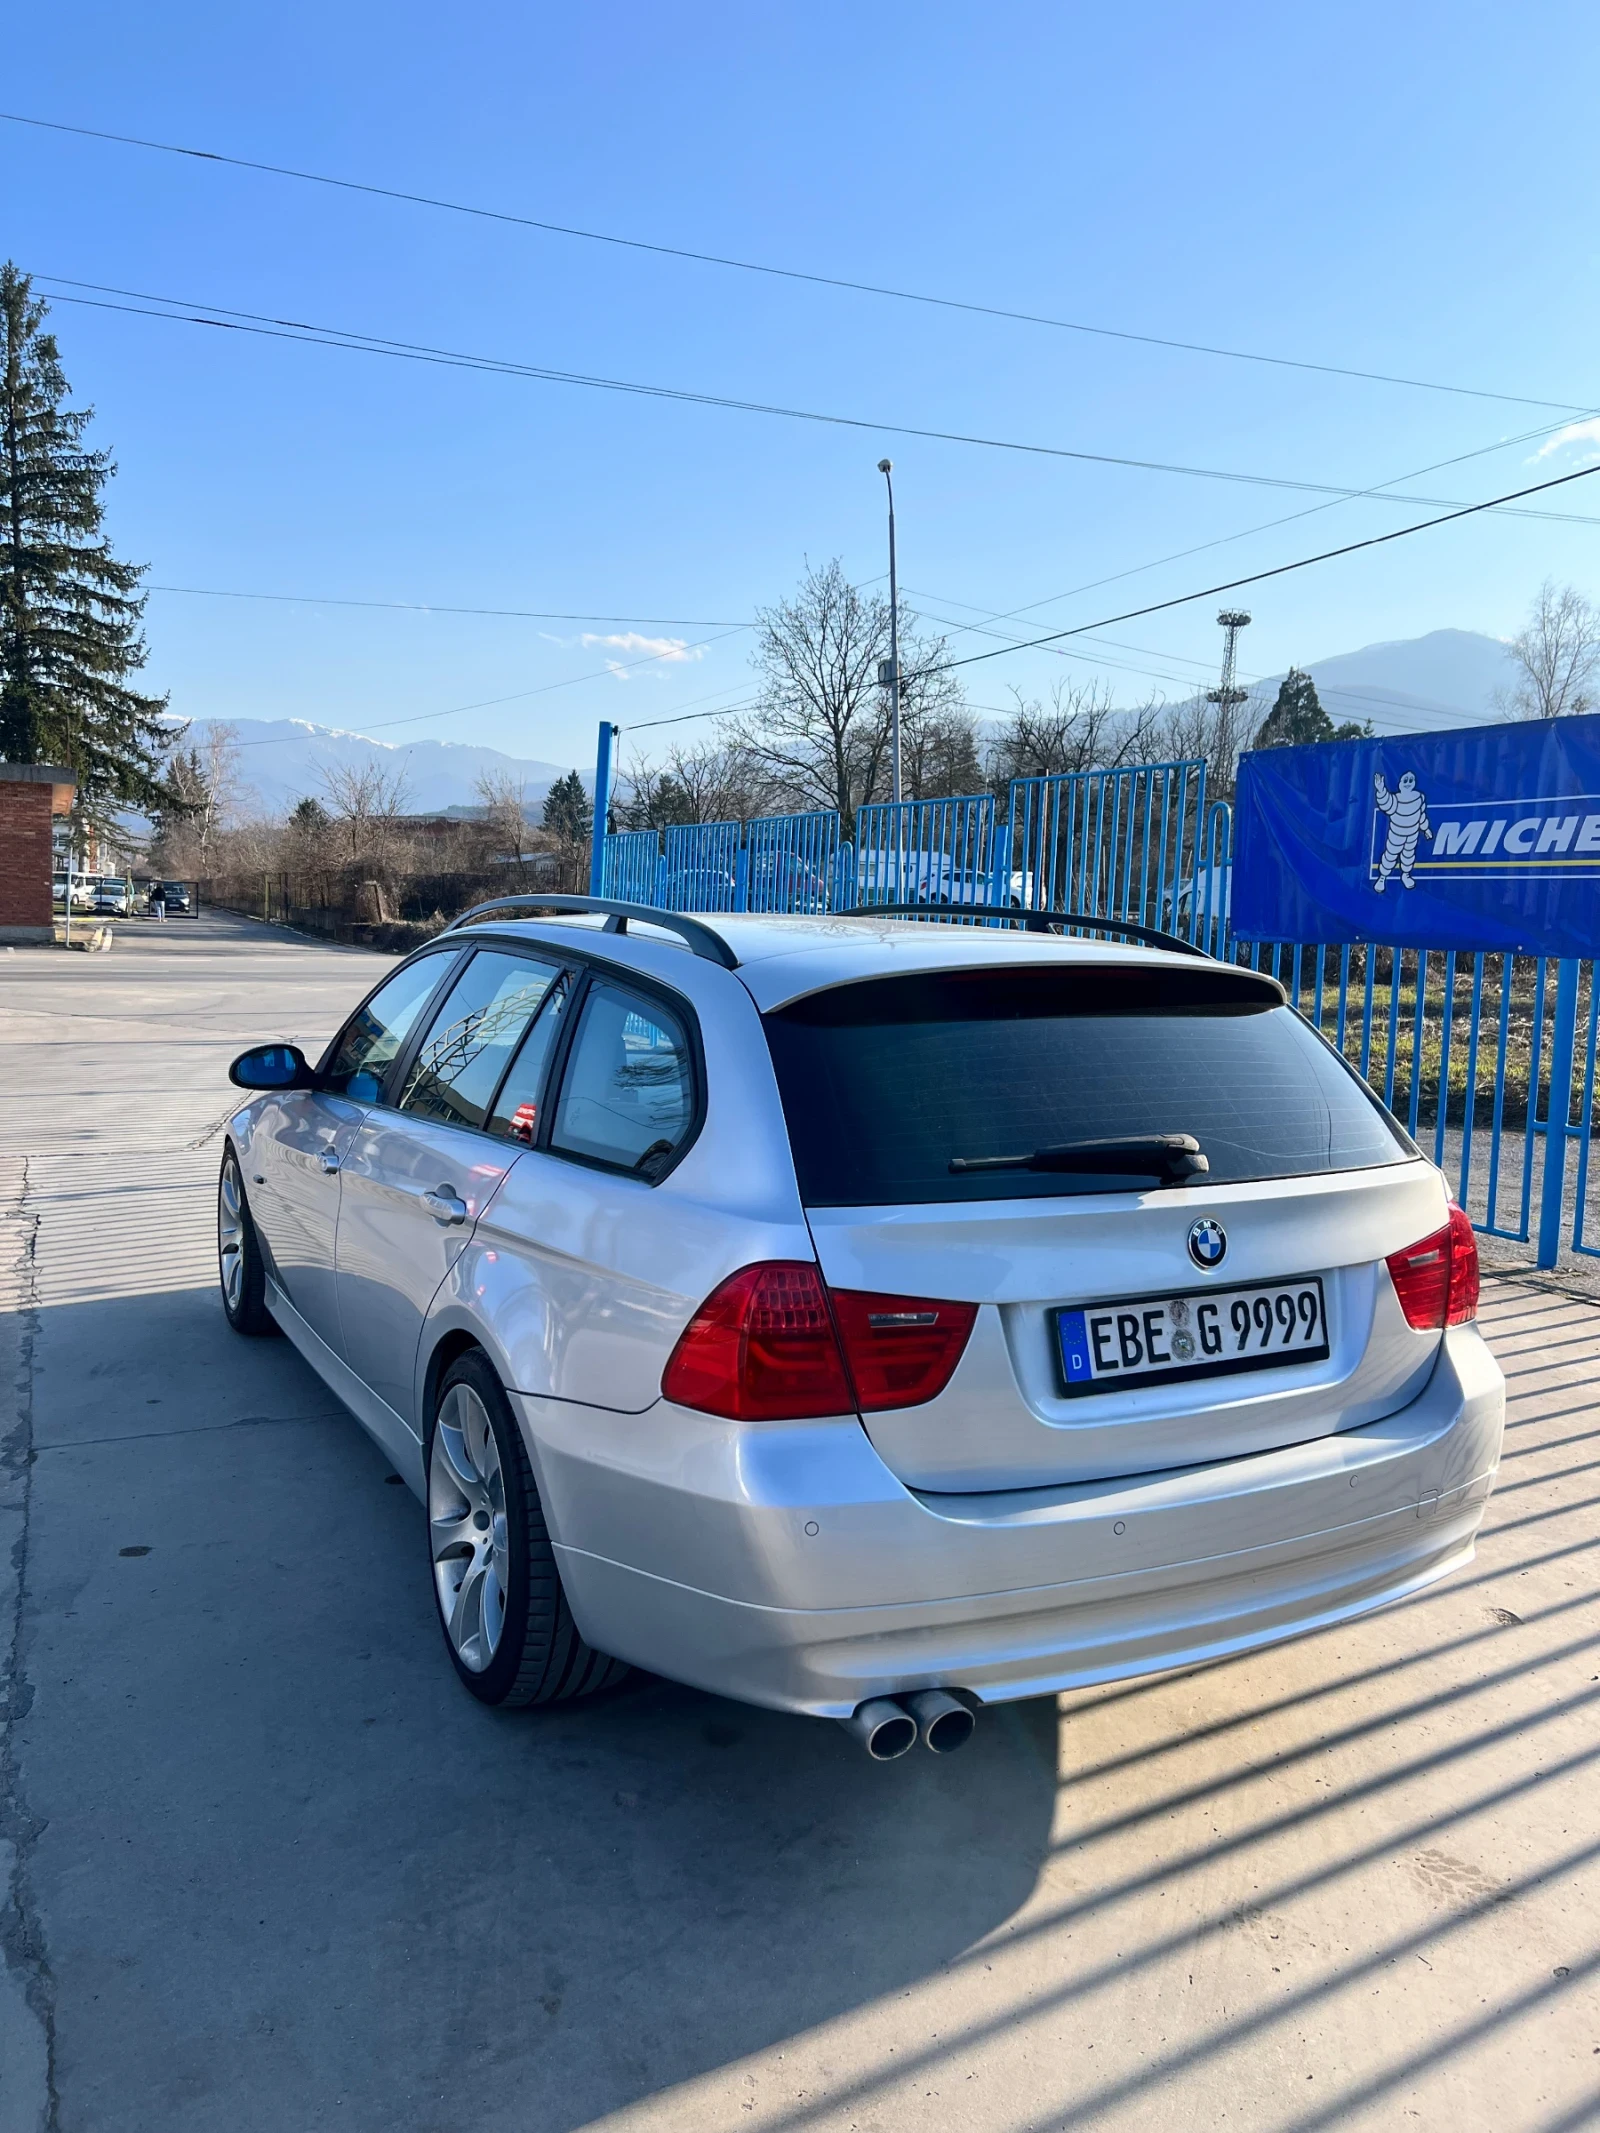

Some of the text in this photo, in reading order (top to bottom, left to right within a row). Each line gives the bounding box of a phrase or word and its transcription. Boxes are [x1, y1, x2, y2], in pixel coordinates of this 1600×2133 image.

[1192, 1220, 1223, 1237] BMW
[1090, 1290, 1317, 1371] EBE G 9999
[1072, 1354, 1083, 1370] D
